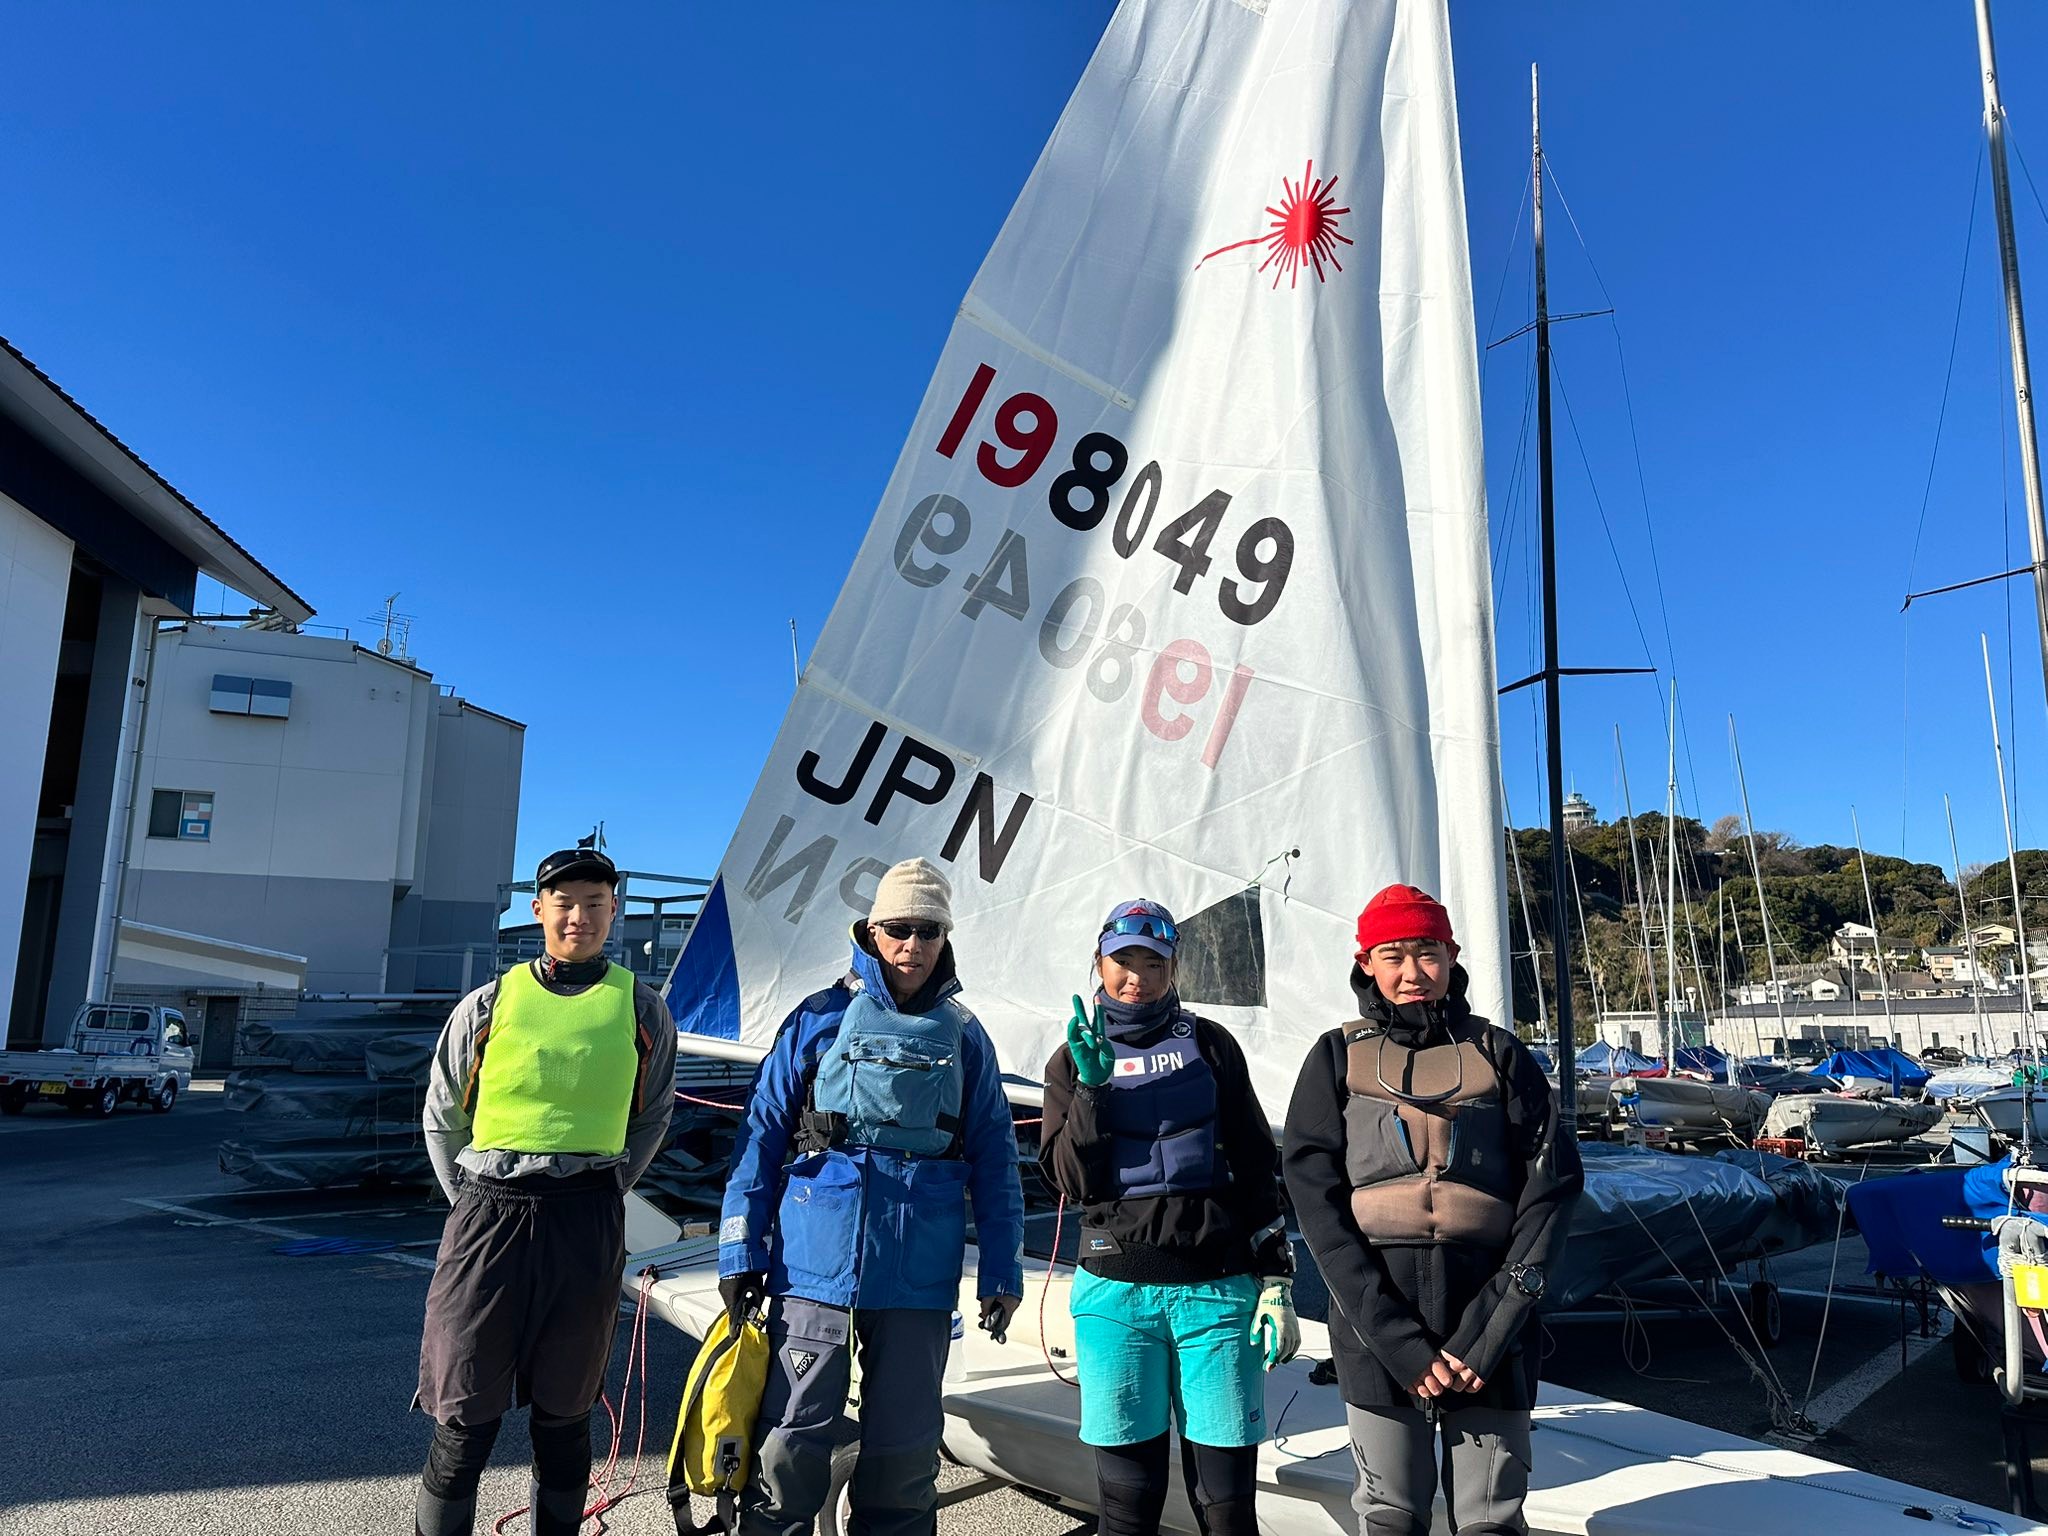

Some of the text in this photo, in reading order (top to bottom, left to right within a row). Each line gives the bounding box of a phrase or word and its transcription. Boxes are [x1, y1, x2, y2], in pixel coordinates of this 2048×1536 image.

[936, 362, 1295, 625] 198049
[796, 721, 1035, 884] JPN
[1150, 1051, 1184, 1074] JPN
[796, 1352, 815, 1376] MPX
